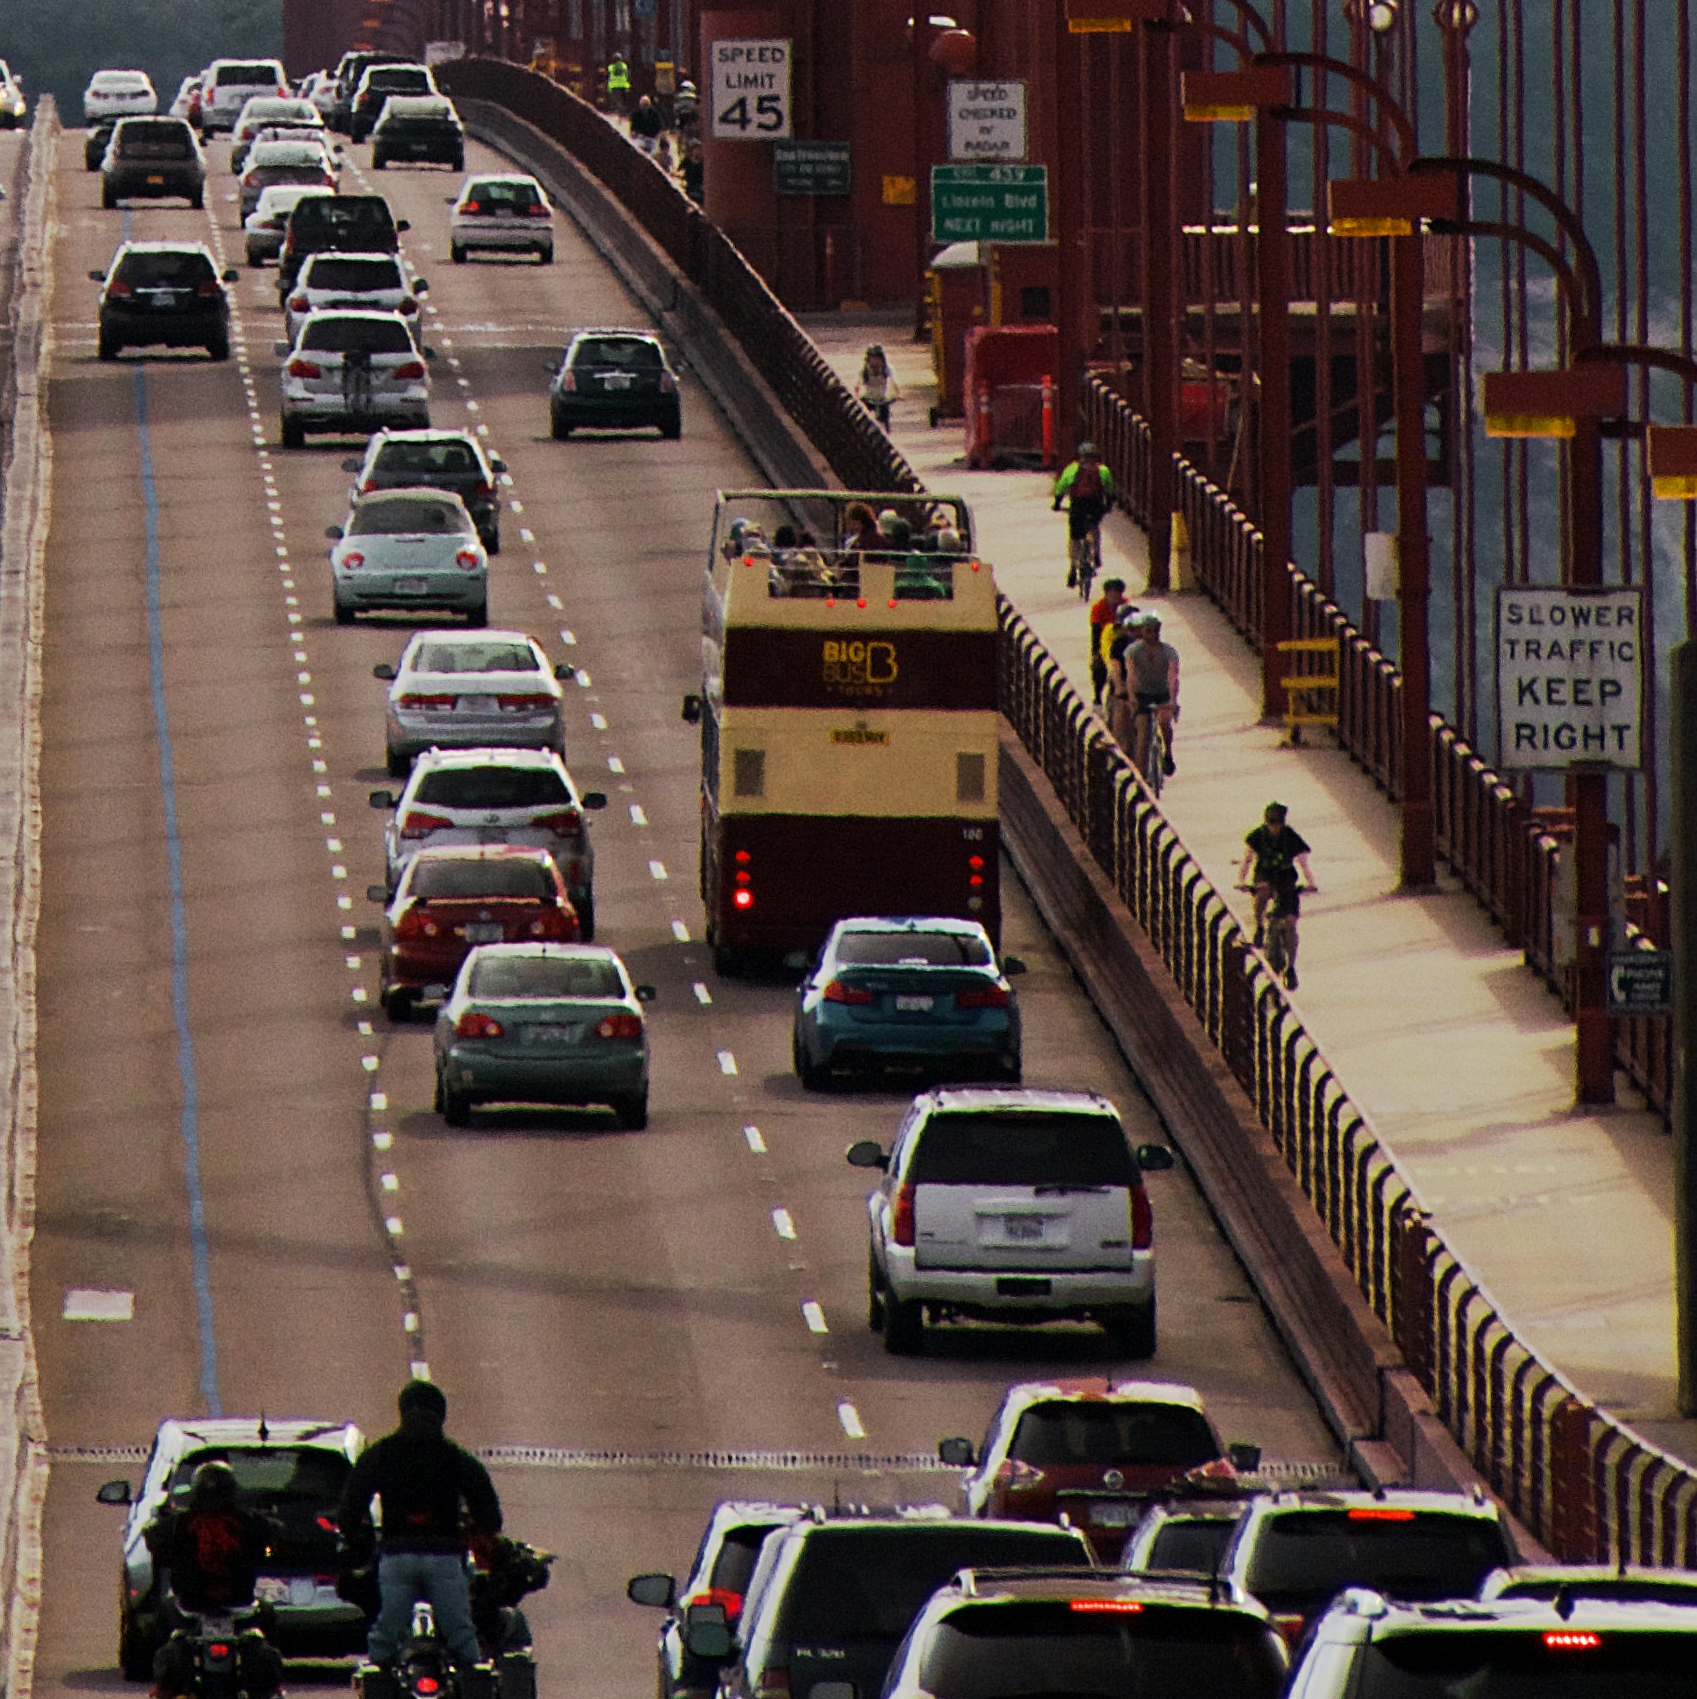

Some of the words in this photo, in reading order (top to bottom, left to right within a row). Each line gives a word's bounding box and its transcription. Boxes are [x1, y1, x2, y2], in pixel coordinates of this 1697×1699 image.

[718, 47, 785, 63] SPEED
[725, 72, 775, 89] LIMIT
[966, 87, 1009, 101] SPEED
[718, 94, 785, 132] 45
[1005, 193, 1038, 209] Blvd
[944, 218, 981, 233] NEXT
[990, 218, 1034, 234] RIGHT
[1506, 603, 1635, 627] SLOWER
[823, 640, 865, 663] BIG
[1506, 638, 1635, 663] TRAFFIC
[823, 663, 865, 683] BUS
[1517, 676, 1623, 707] KEEP
[1514, 721, 1631, 752] RIGHT
